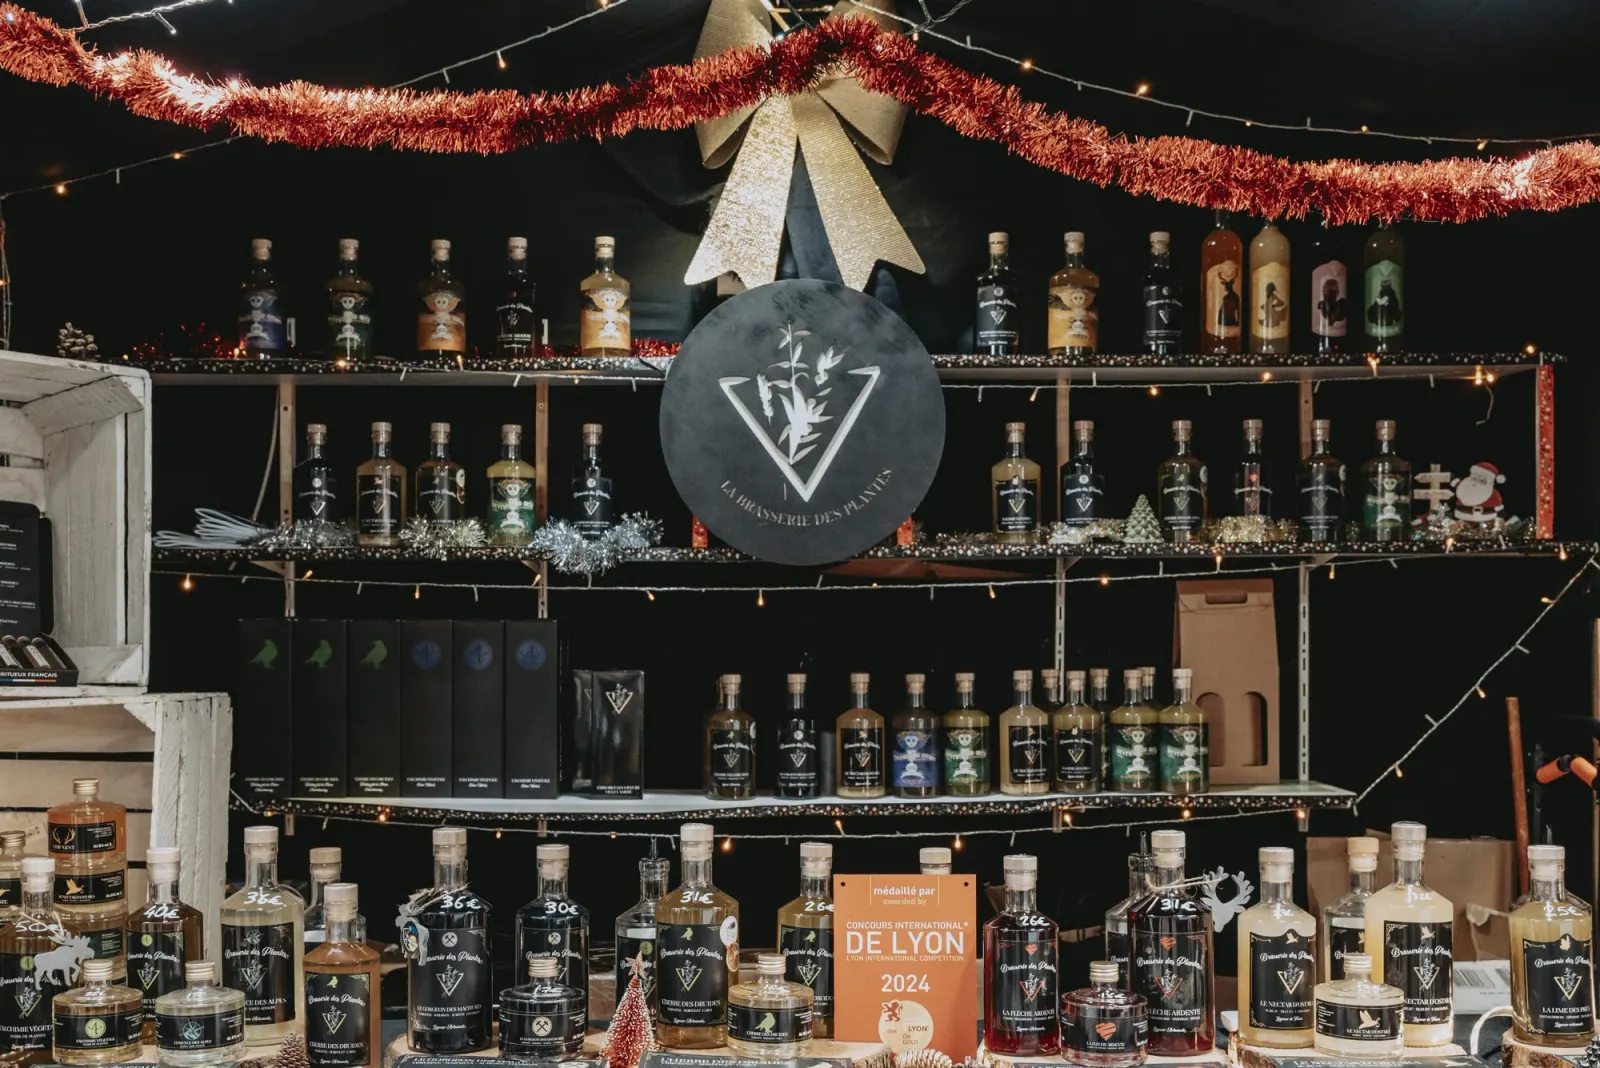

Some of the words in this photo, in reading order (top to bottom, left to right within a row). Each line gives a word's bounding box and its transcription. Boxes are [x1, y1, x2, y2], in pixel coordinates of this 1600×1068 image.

[721, 479, 737, 499] LA
[736, 493, 811, 527] BRASSERIE
[814, 510, 842, 528] DES
[843, 467, 893, 516] PLANTES
[680, 890, 714, 904] 31€
[873, 886, 916, 896] médaillé
[918, 889, 935, 899] par
[440, 894, 481, 909] 36€
[805, 901, 834, 912] 26€
[918, 898, 926, 906] by
[1160, 898, 1197, 912] 31€
[144, 904, 180, 919] 40€
[545, 901, 579, 915] 30€
[846, 921, 893, 929] CONCOURS
[1019, 914, 1050, 926] 26€
[846, 931, 882, 954] DE
[892, 931, 964, 954] LYON
[250, 946, 261, 956] des
[685, 947, 695, 957] des
[1259, 952, 1288, 963] Brasserie
[1288, 951, 1298, 961] des
[1391, 947, 1424, 959] Brasserie
[1424, 946, 1434, 956] des
[446, 952, 456, 962] des
[457, 950, 484, 965] Plantes
[1136, 956, 1164, 968] Brasserie
[1165, 956, 1175, 966] des
[1534, 957, 1564, 969] Brasserie
[1564, 956, 1574, 965] des
[1000, 963, 1027, 974] Brasserie
[1028, 962, 1037, 971] des
[881, 973, 930, 993] 2024
[330, 993, 340, 1003] des
[681, 999, 694, 1007] DES
[1268, 1000, 1292, 1008] NECTAR
[1148, 1006, 1171, 1016] LÈCHE
[1171, 1007, 1201, 1017] ARDENTE
[1542, 1006, 1551, 1014] LA
[1551, 1006, 1569, 1014] LIME
[1569, 1006, 1580, 1014] DES
